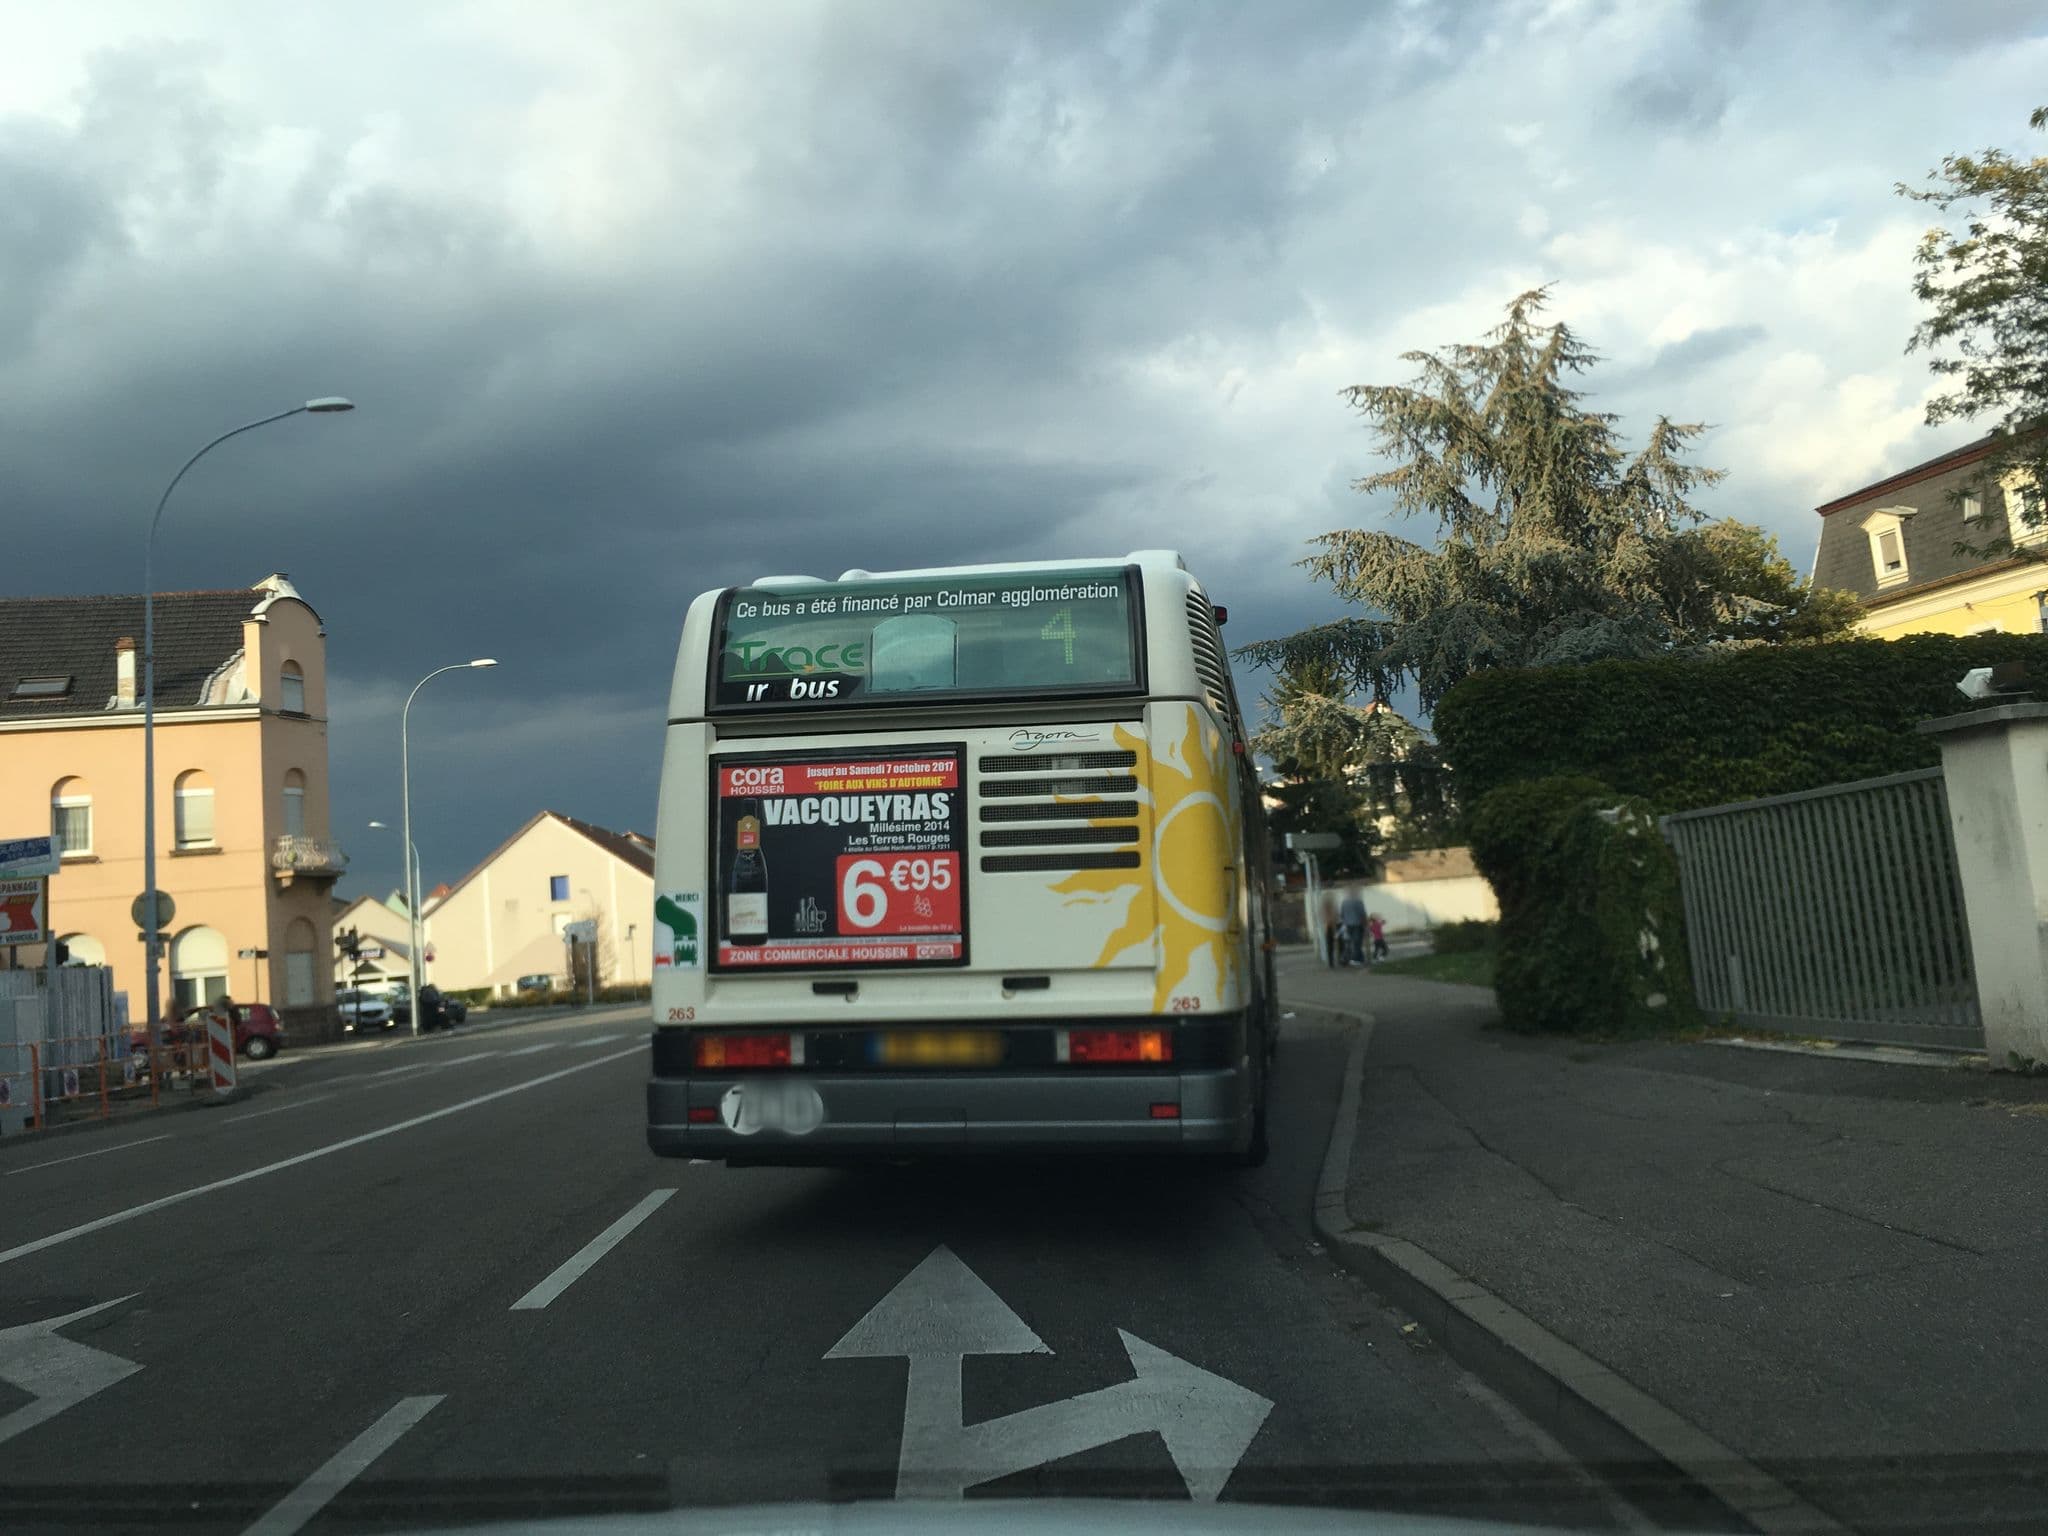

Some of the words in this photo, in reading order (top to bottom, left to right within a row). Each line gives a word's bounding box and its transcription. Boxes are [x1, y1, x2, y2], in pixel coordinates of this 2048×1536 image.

[737, 602, 757, 618] Ce
[762, 602, 790, 616] bus
[796, 604, 805, 615] a
[811, 598, 837, 614] été
[842, 595, 899, 612] financé
[904, 594, 932, 613] par
[937, 590, 996, 607] Colmar
[1001, 583, 1118, 607] agglomération
[1041, 608, 1076, 664] 4
[790, 678, 840, 700] bus
[1009, 730, 1099, 751] Agora
[849, 764, 884, 776] Samedi
[886, 764, 892, 774] 7
[893, 762, 930, 774] octobre
[932, 761, 954, 772] 2017
[730, 768, 784, 786] cora
[846, 779, 865, 789] AUX
[866, 778, 887, 788] VINS
[730, 785, 784, 795] HOUSSEN
[870, 821, 921, 833] Millésime
[924, 821, 950, 831] 2014
[849, 835, 868, 845] Les
[870, 834, 904, 844] Terres
[907, 833, 950, 845] Rouges
[675, 893, 699, 903] MERCI
[729, 950, 760, 962] ZONE
[764, 948, 849, 961] COMMERCIALE
[852, 947, 908, 958] HOUSSEN
[1172, 996, 1200, 1012] 263
[668, 1007, 695, 1021] 263
